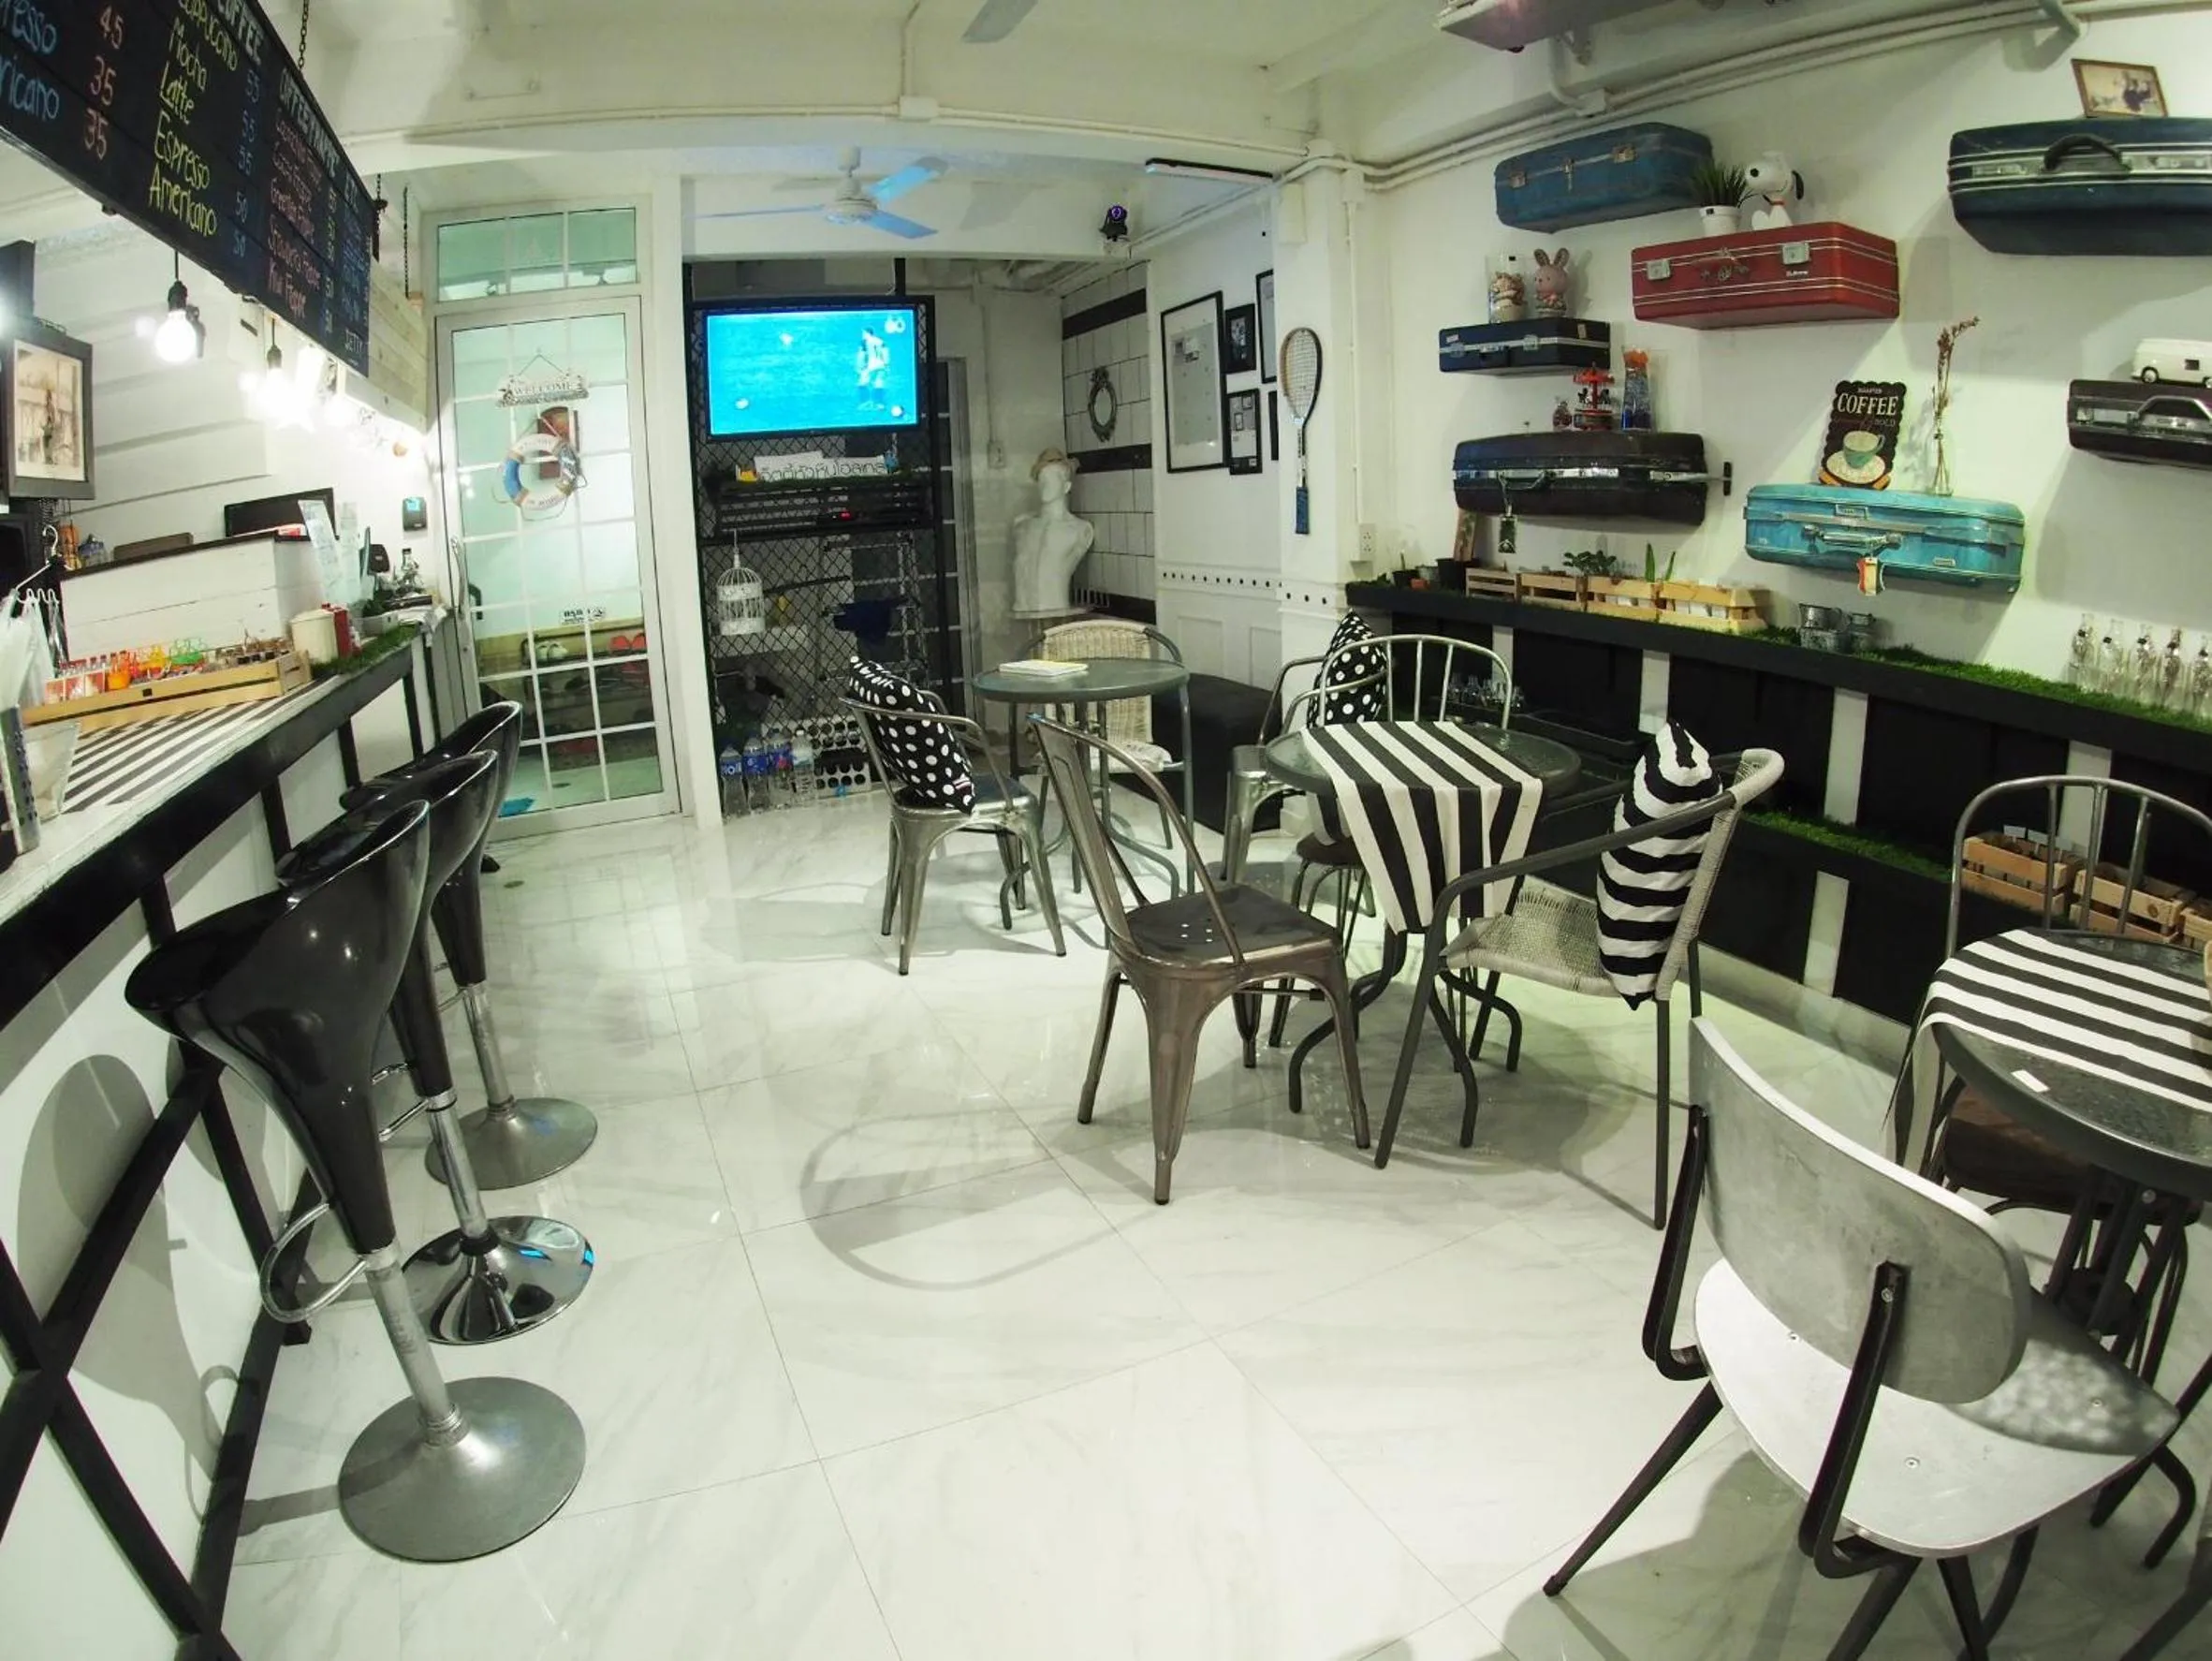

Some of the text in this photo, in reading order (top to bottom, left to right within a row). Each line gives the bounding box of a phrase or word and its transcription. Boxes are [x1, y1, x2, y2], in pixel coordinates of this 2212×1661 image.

[91, 55, 116, 106] 35
[160, 61, 195, 125] Latte
[154, 110, 210, 190] Espresso
[149, 162, 218, 236] Americano
[1838, 393, 1898, 416] COFFEE
